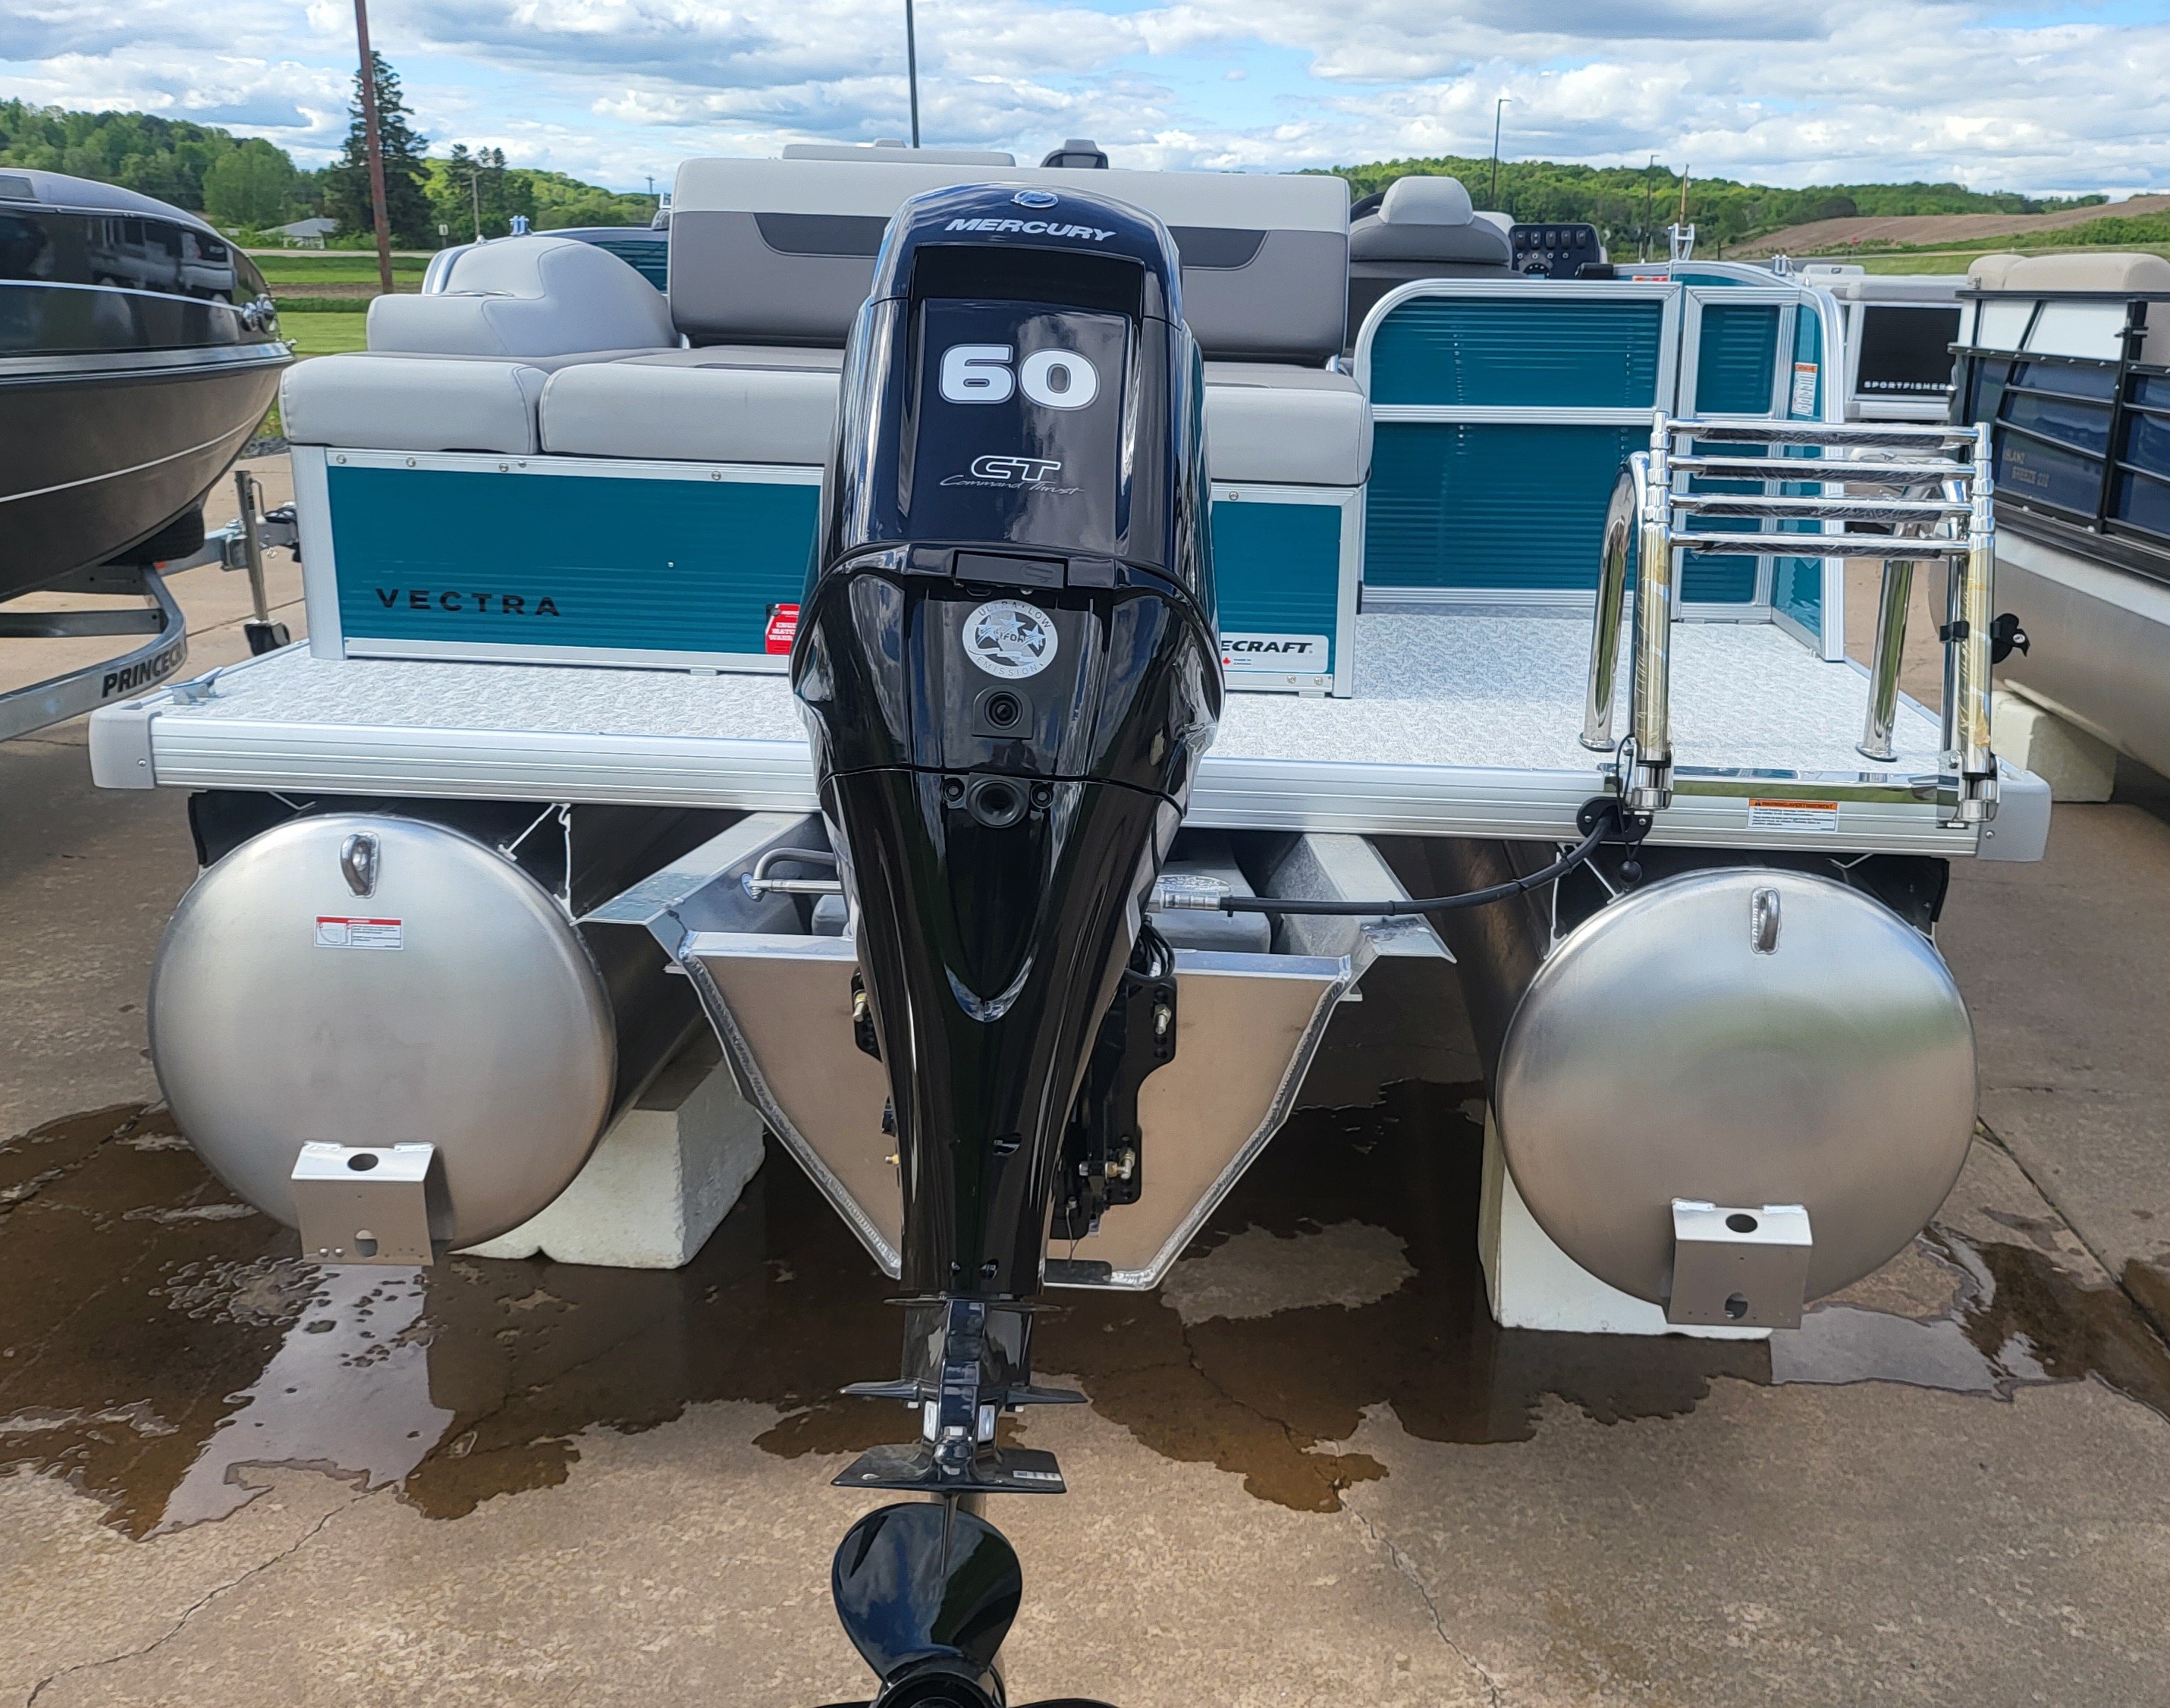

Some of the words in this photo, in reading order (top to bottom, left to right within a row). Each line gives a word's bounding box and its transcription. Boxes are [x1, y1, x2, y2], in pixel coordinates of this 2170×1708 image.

[945, 218, 1117, 241] MERCURY
[938, 344, 1100, 411] 60
[375, 588, 560, 616] VECTRA
[1029, 608, 1051, 628] LOW
[977, 656, 1038, 676] EMISSION
